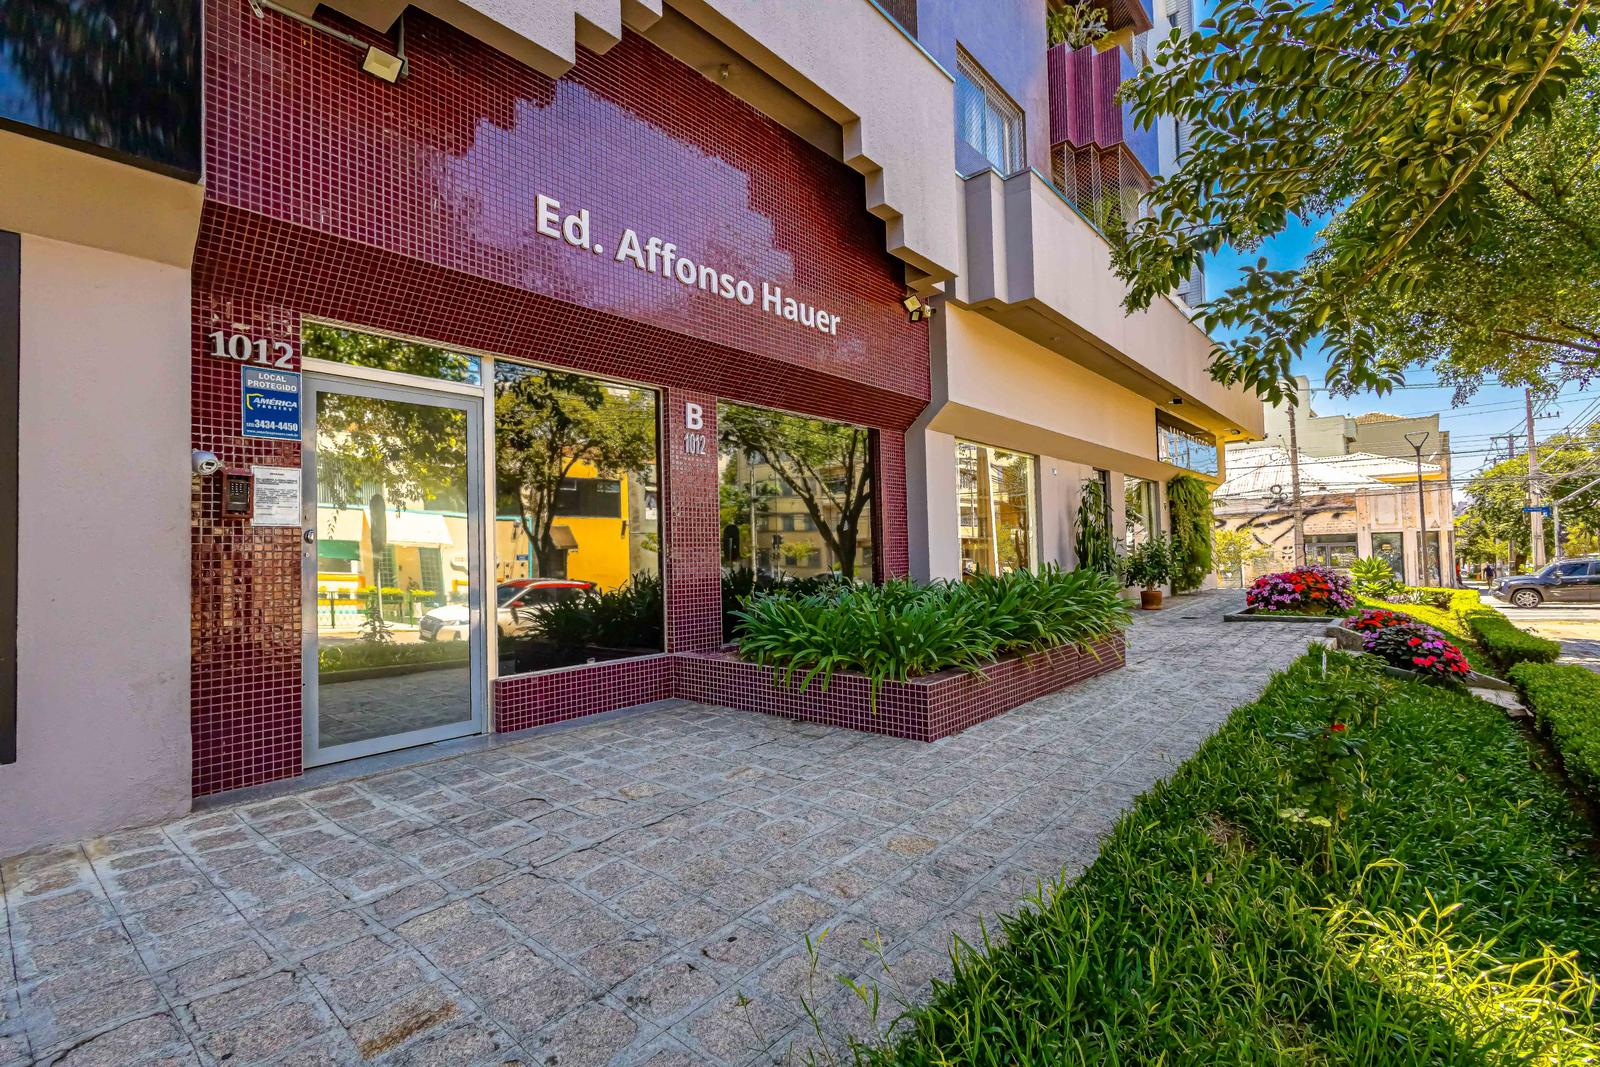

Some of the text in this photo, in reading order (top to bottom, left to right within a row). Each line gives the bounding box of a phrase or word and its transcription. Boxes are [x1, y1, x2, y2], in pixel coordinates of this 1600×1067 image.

[536, 193, 841, 336] Ed. Affonso Hauer
[208, 330, 294, 369] 1012
[247, 379, 297, 392] PROTEGIDO
[258, 372, 287, 383] LOCAL
[252, 397, 298, 408] AMÉRICA
[685, 402, 704, 430] B
[254, 419, 298, 432] 3434-4450
[684, 432, 706, 455] 1012
